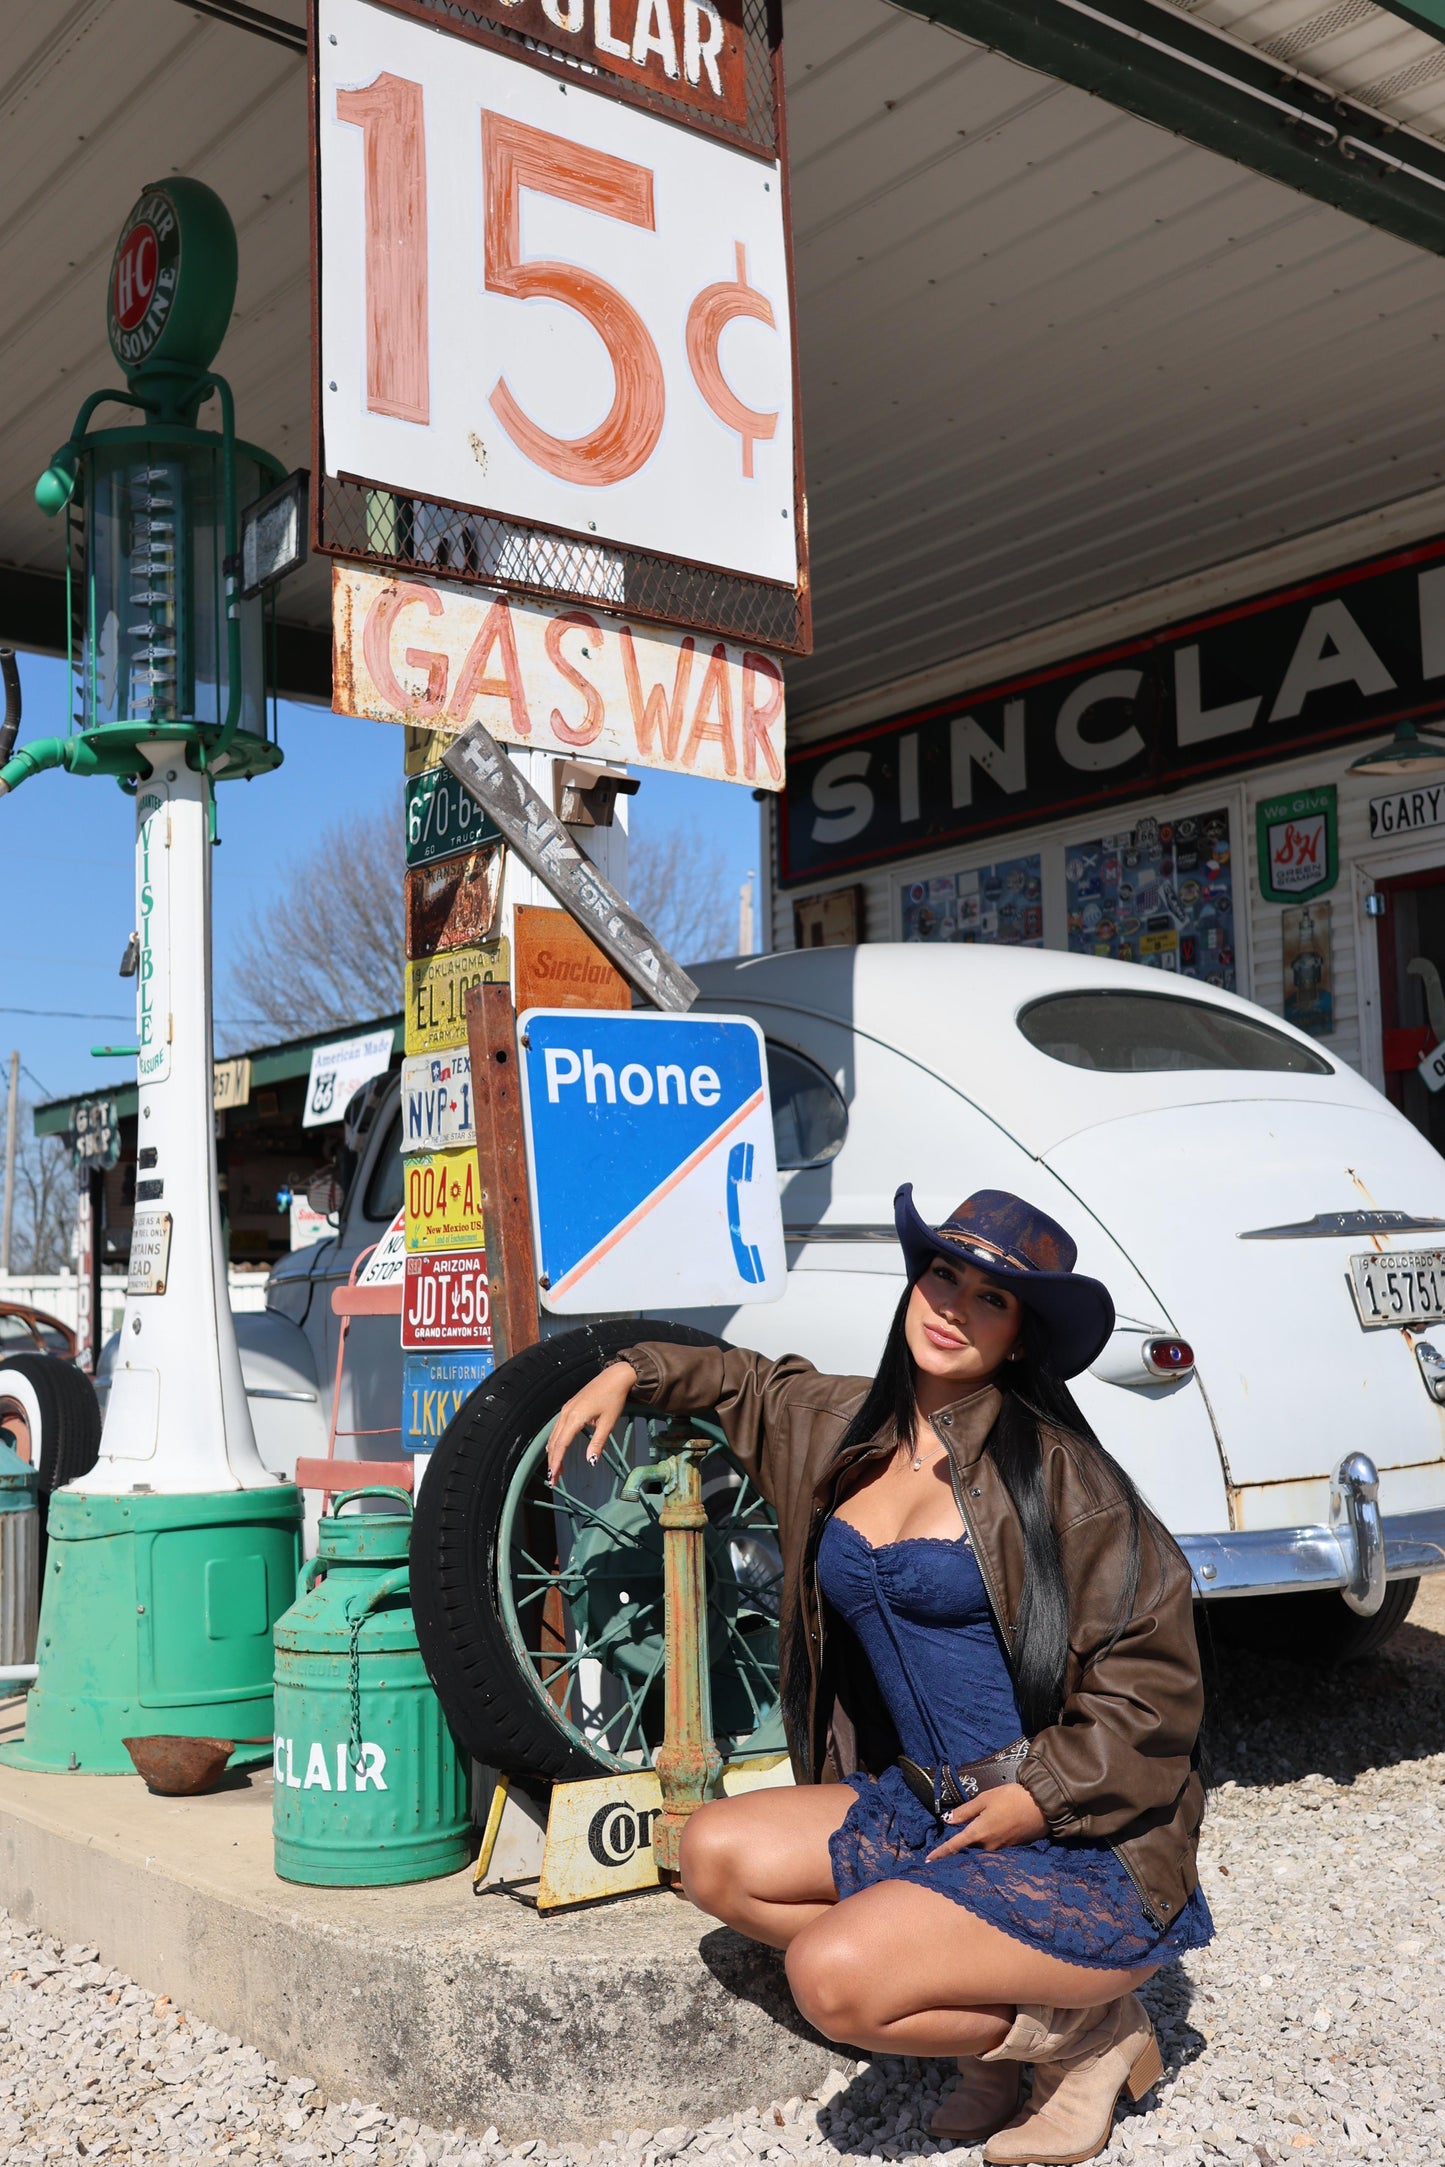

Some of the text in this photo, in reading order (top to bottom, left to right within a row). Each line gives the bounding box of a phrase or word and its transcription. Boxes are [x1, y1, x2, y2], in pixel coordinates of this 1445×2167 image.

[111, 267, 176, 358] GASOLINE
[363, 580, 604, 746] GAS
[1264, 796, 1328, 819] We Give
[450, 828, 483, 847] TRUCK
[1274, 823, 1323, 865] S&H
[140, 819, 154, 1046] VISIBLE
[428, 953, 485, 980] OKLAHOMA
[534, 950, 614, 986] Sinclair
[428, 1030, 450, 1044] FARM
[544, 1047, 722, 1107] Phone
[313, 1081, 333, 1112] 66
[409, 1087, 448, 1139] NVP
[450, 1131, 466, 1140] STAR
[410, 1165, 447, 1219] 004
[150, 1228, 168, 1237] ONLY
[426, 1225, 441, 1235] New
[443, 1223, 470, 1233] Mexico
[129, 1260, 151, 1276] LEAD
[366, 1261, 403, 1282] STOP
[433, 1258, 480, 1273] ARIZONA
[1380, 1255, 1434, 1269] COLORADO
[408, 1274, 452, 1326] JDT
[414, 1327, 441, 1338] GRAND
[441, 1326, 472, 1338] CANYON
[430, 1365, 486, 1380] CALIFORNIA
[273, 1732, 388, 1792] CLAIR
